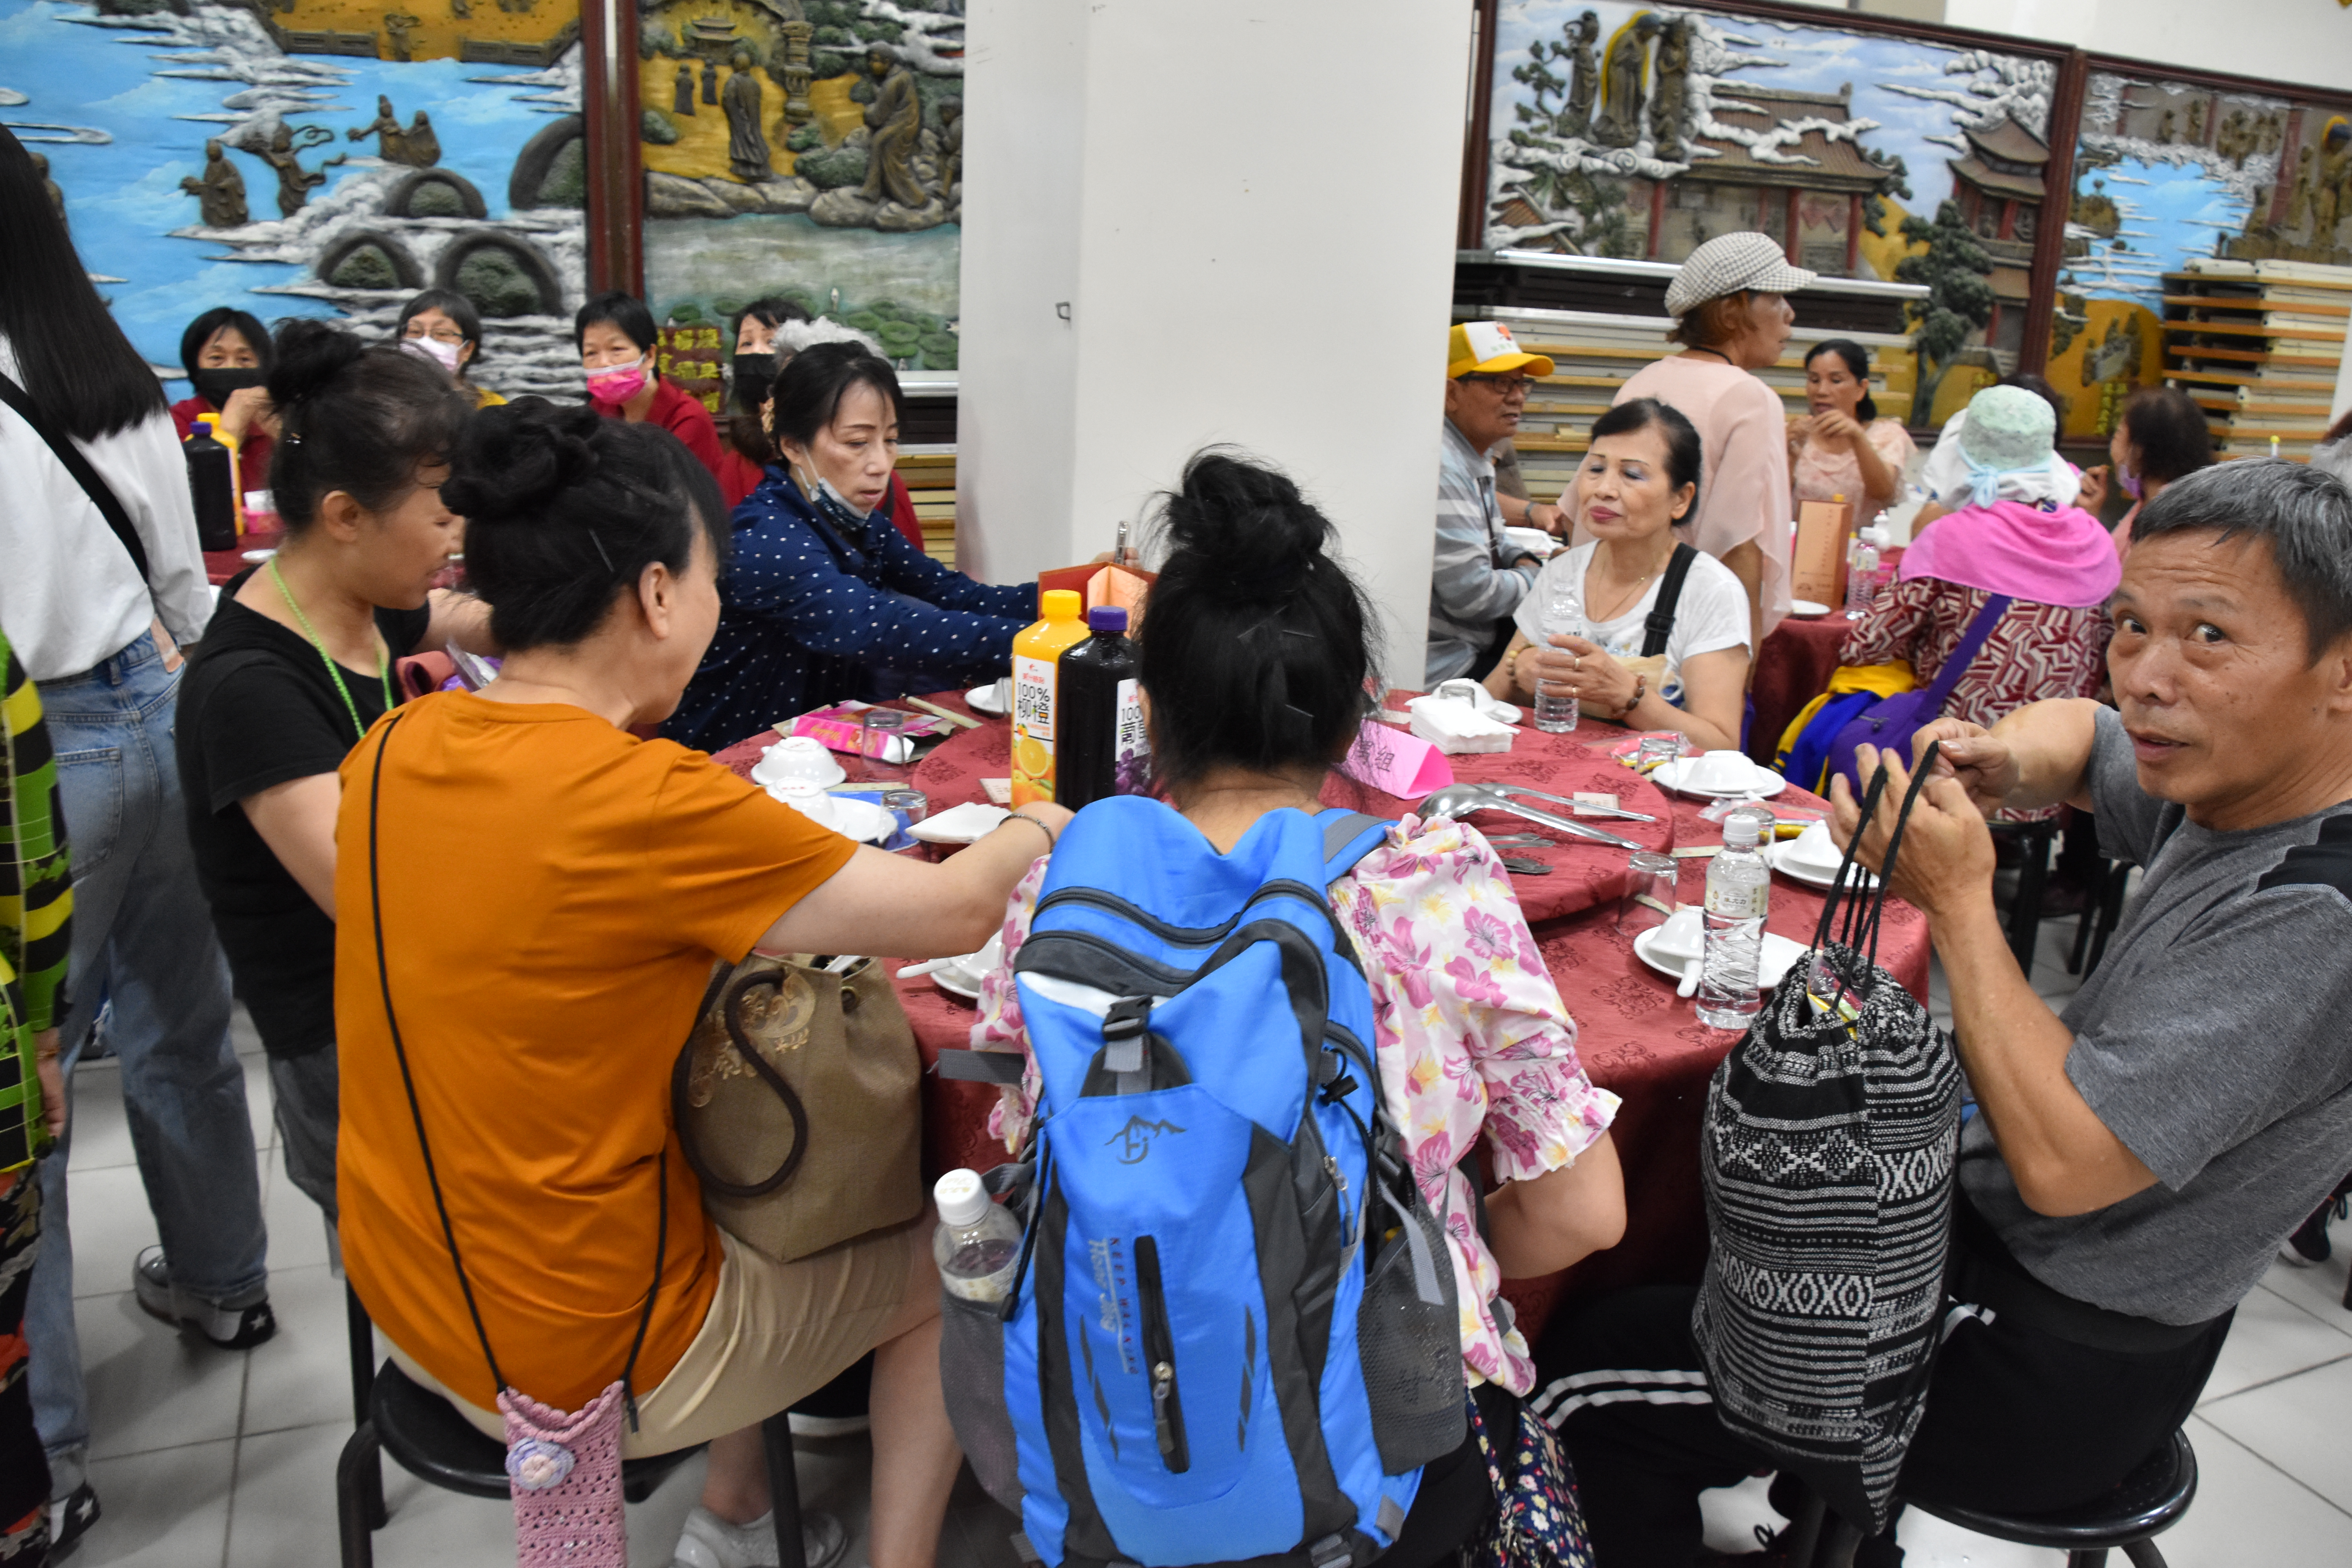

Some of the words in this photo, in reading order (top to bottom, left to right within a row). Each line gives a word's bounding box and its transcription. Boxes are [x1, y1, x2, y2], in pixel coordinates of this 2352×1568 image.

[1017, 682, 1050, 702] 100%
[1017, 697, 1050, 725] 柳橙
[1110, 1237, 1126, 1286] KEEP
